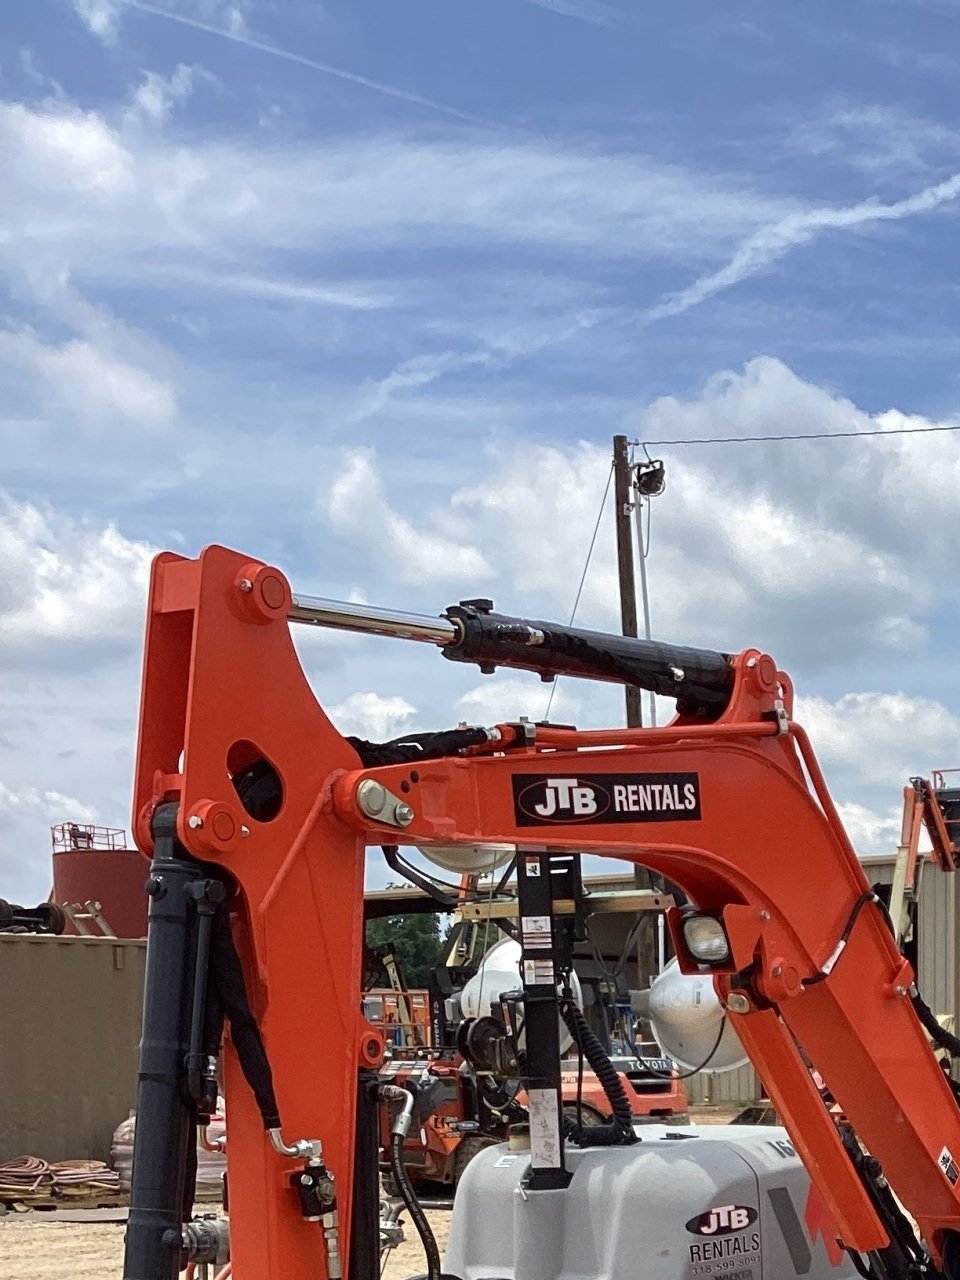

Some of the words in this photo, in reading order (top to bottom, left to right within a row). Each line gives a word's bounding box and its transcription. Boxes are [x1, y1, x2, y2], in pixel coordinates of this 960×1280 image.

[535, 778, 597, 816] JTB
[613, 783, 696, 812] RENTALS
[628, 1060, 668, 1071] TOYOTA
[700, 1204, 749, 1234] JTB
[690, 1233, 760, 1262] RENTALS
